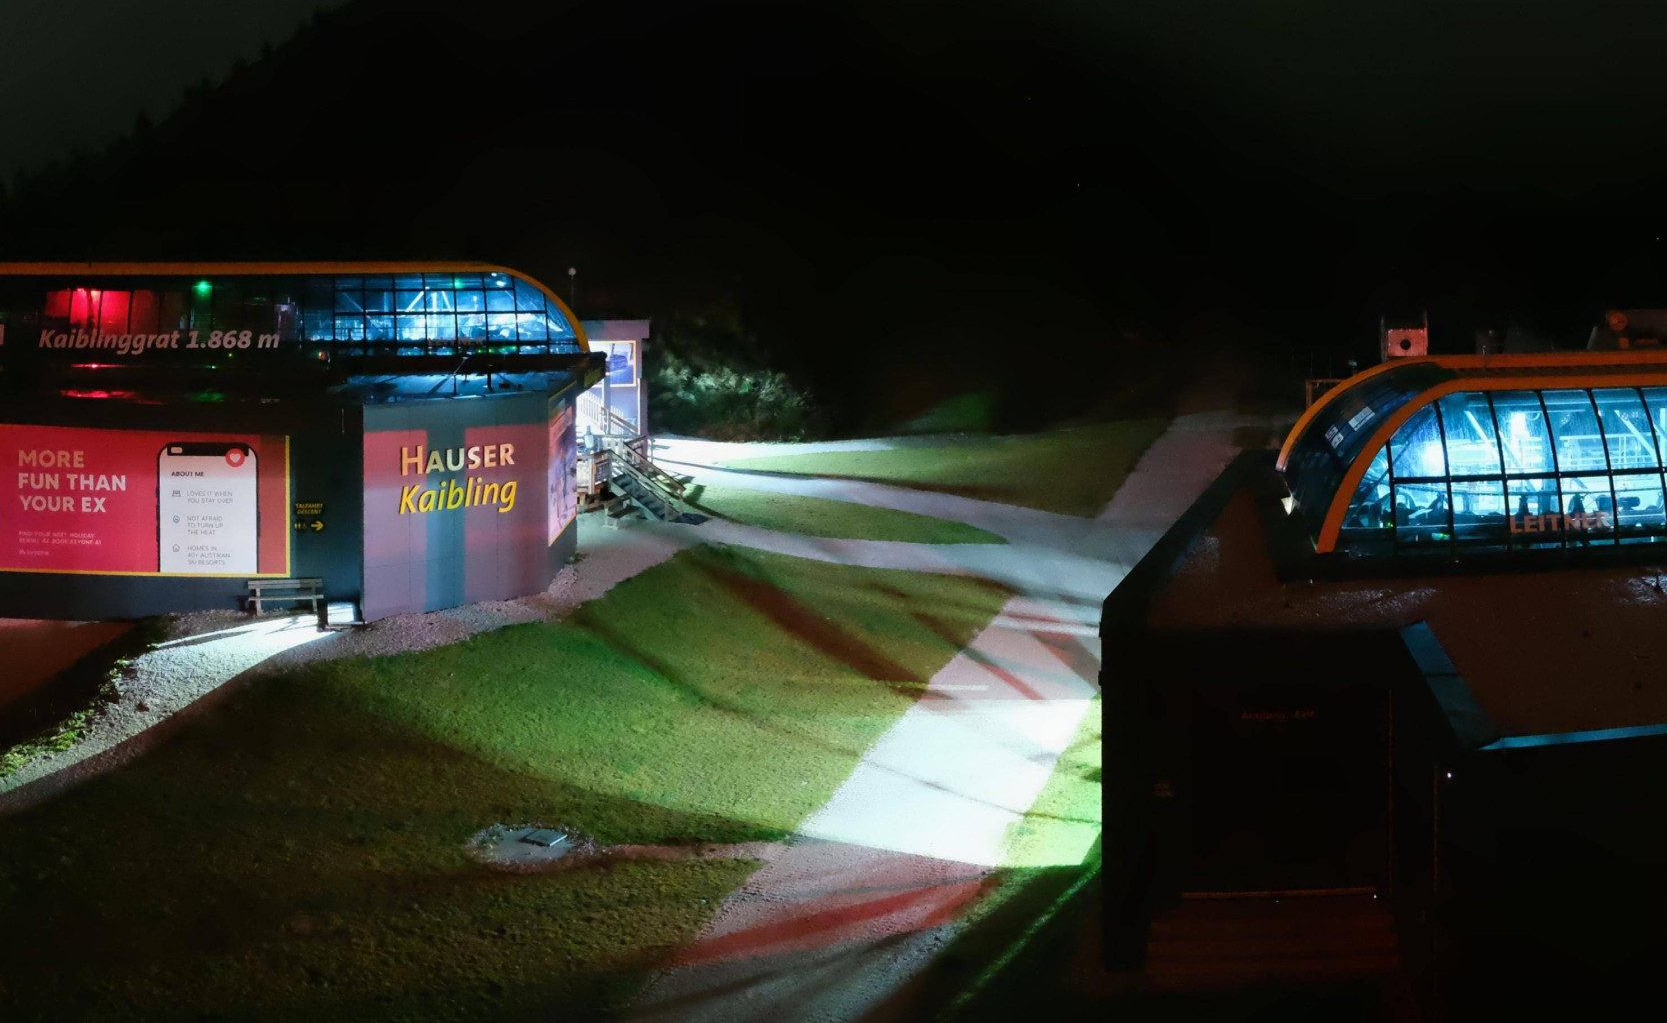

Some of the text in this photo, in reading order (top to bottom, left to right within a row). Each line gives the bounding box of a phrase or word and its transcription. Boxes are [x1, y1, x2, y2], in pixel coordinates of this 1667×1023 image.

[39, 329, 280, 355] Kaiblinggrat 1.868 m
[18, 449, 85, 468] MORE
[400, 443, 516, 476] HAUSER
[18, 472, 127, 491] FUN THAN
[19, 495, 107, 513] YOUR EX
[399, 476, 518, 515] Kaibling
[1510, 511, 1611, 534] LEITNER
